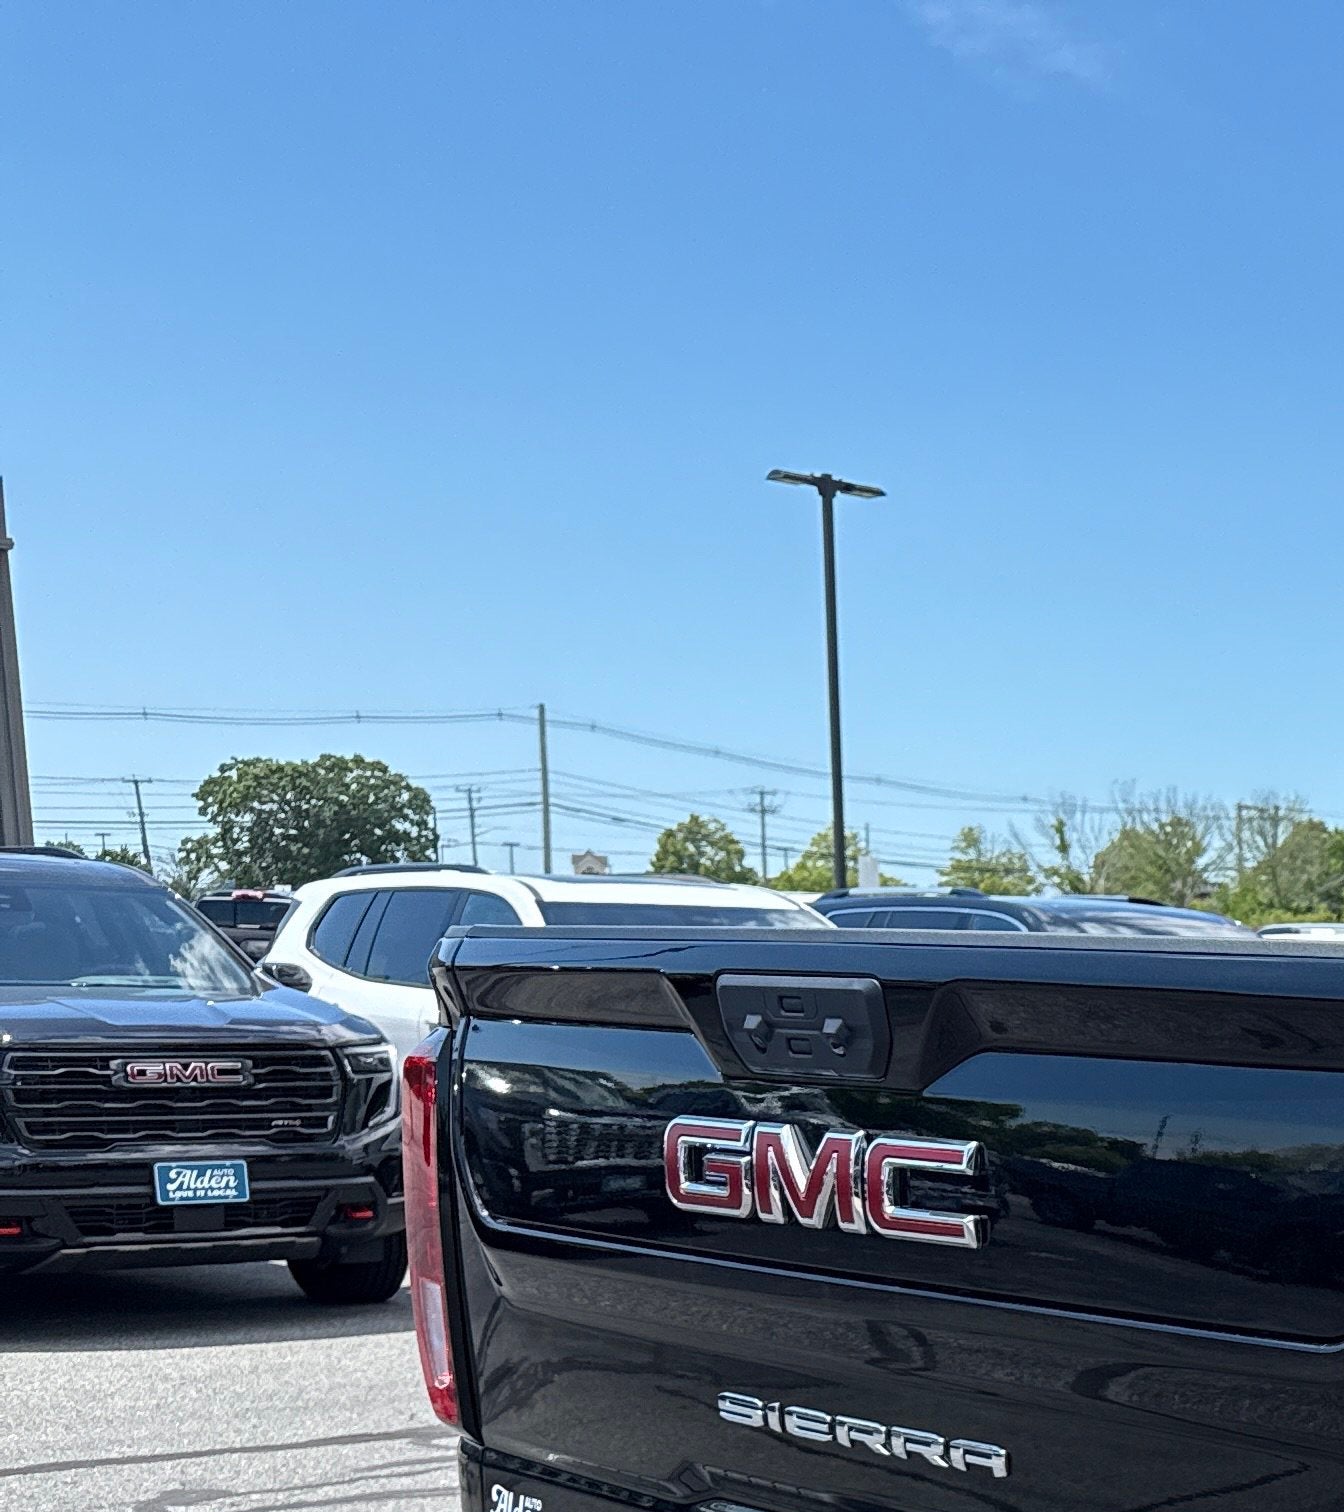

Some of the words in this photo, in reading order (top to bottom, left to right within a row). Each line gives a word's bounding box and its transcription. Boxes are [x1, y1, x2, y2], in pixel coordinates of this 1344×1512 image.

[126, 1062, 244, 1083] GMC
[166, 1168, 239, 1191] Alden
[212, 1168, 235, 1176] AUTO
[664, 1115, 988, 1249] GMC
[168, 1190, 194, 1199] LOVE
[196, 1189, 206, 1198] IT
[207, 1188, 239, 1197] LOCAL
[717, 1391, 1010, 1478] SIERRA
